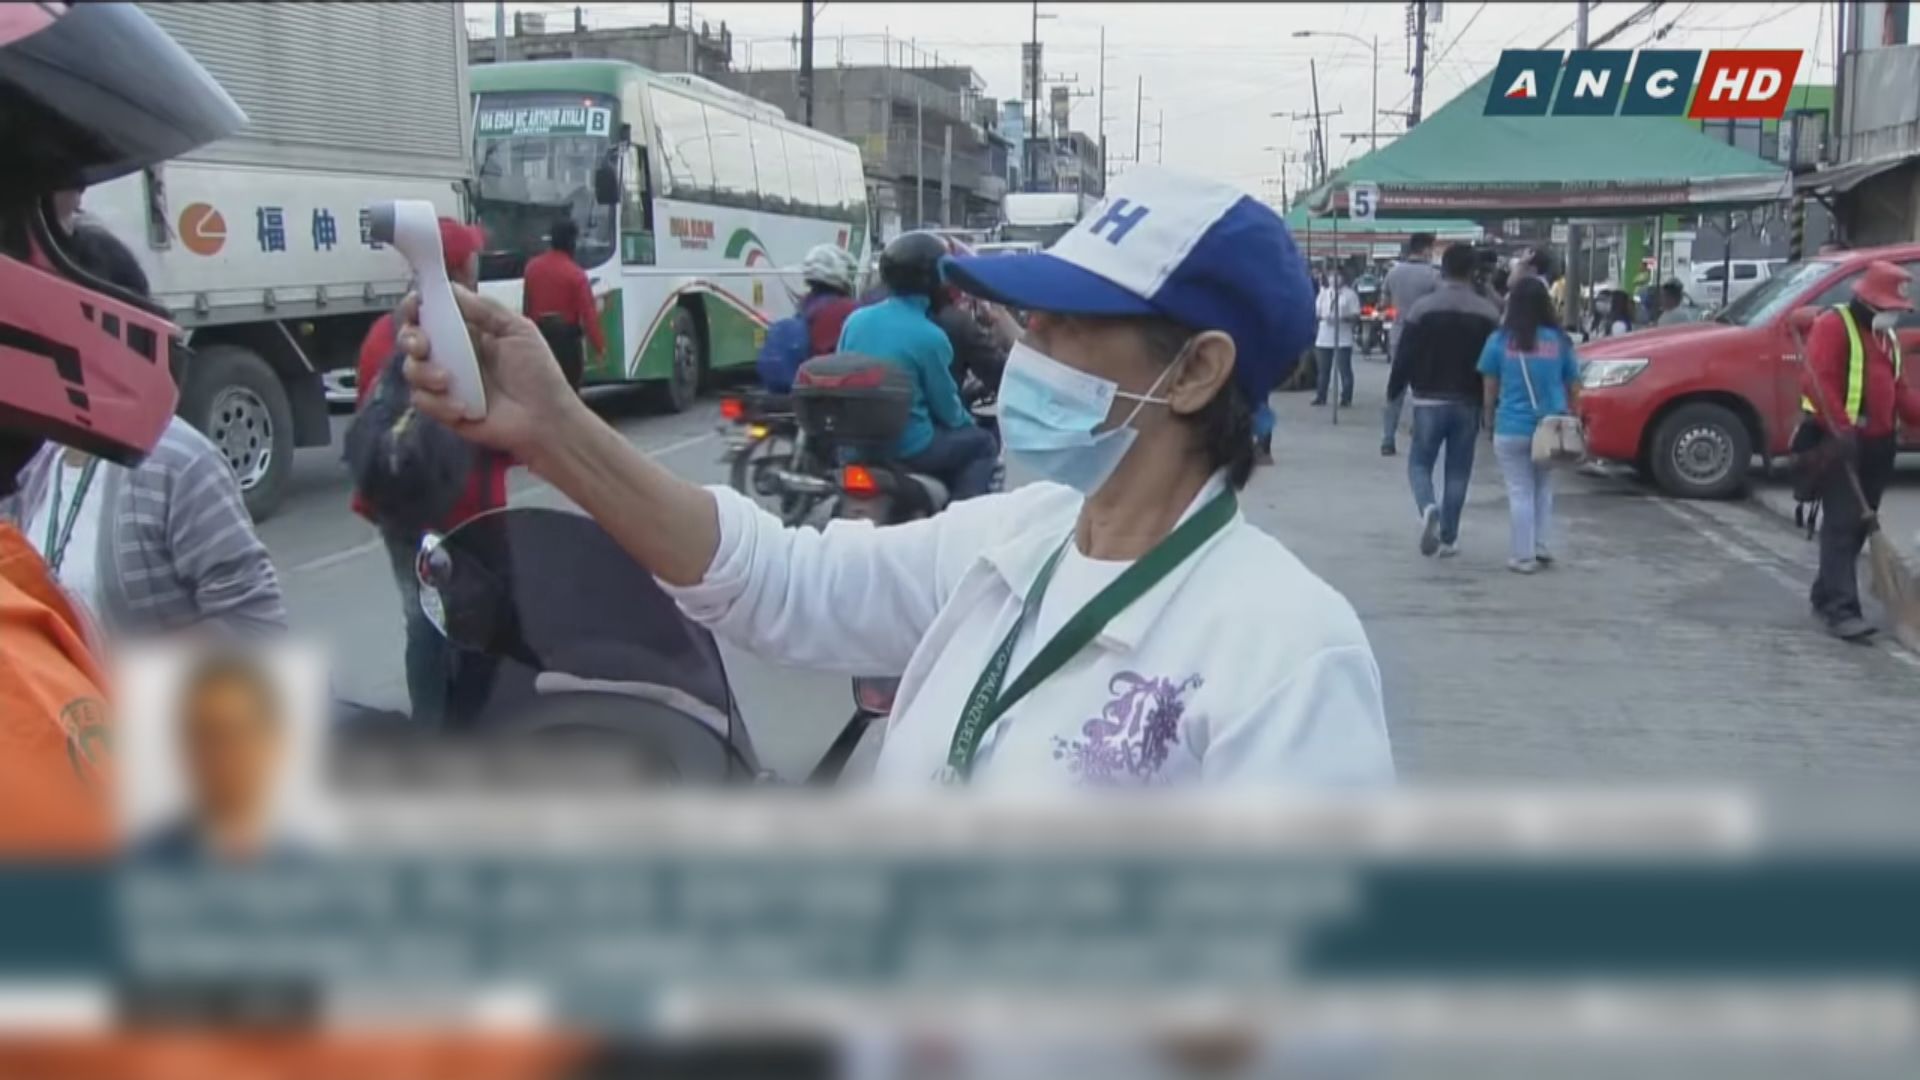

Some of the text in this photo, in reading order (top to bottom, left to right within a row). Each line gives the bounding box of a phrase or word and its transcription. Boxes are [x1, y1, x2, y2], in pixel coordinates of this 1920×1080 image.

[592, 111, 605, 131] B
[1355, 190, 1369, 217] 5
[1089, 199, 1149, 245] H
